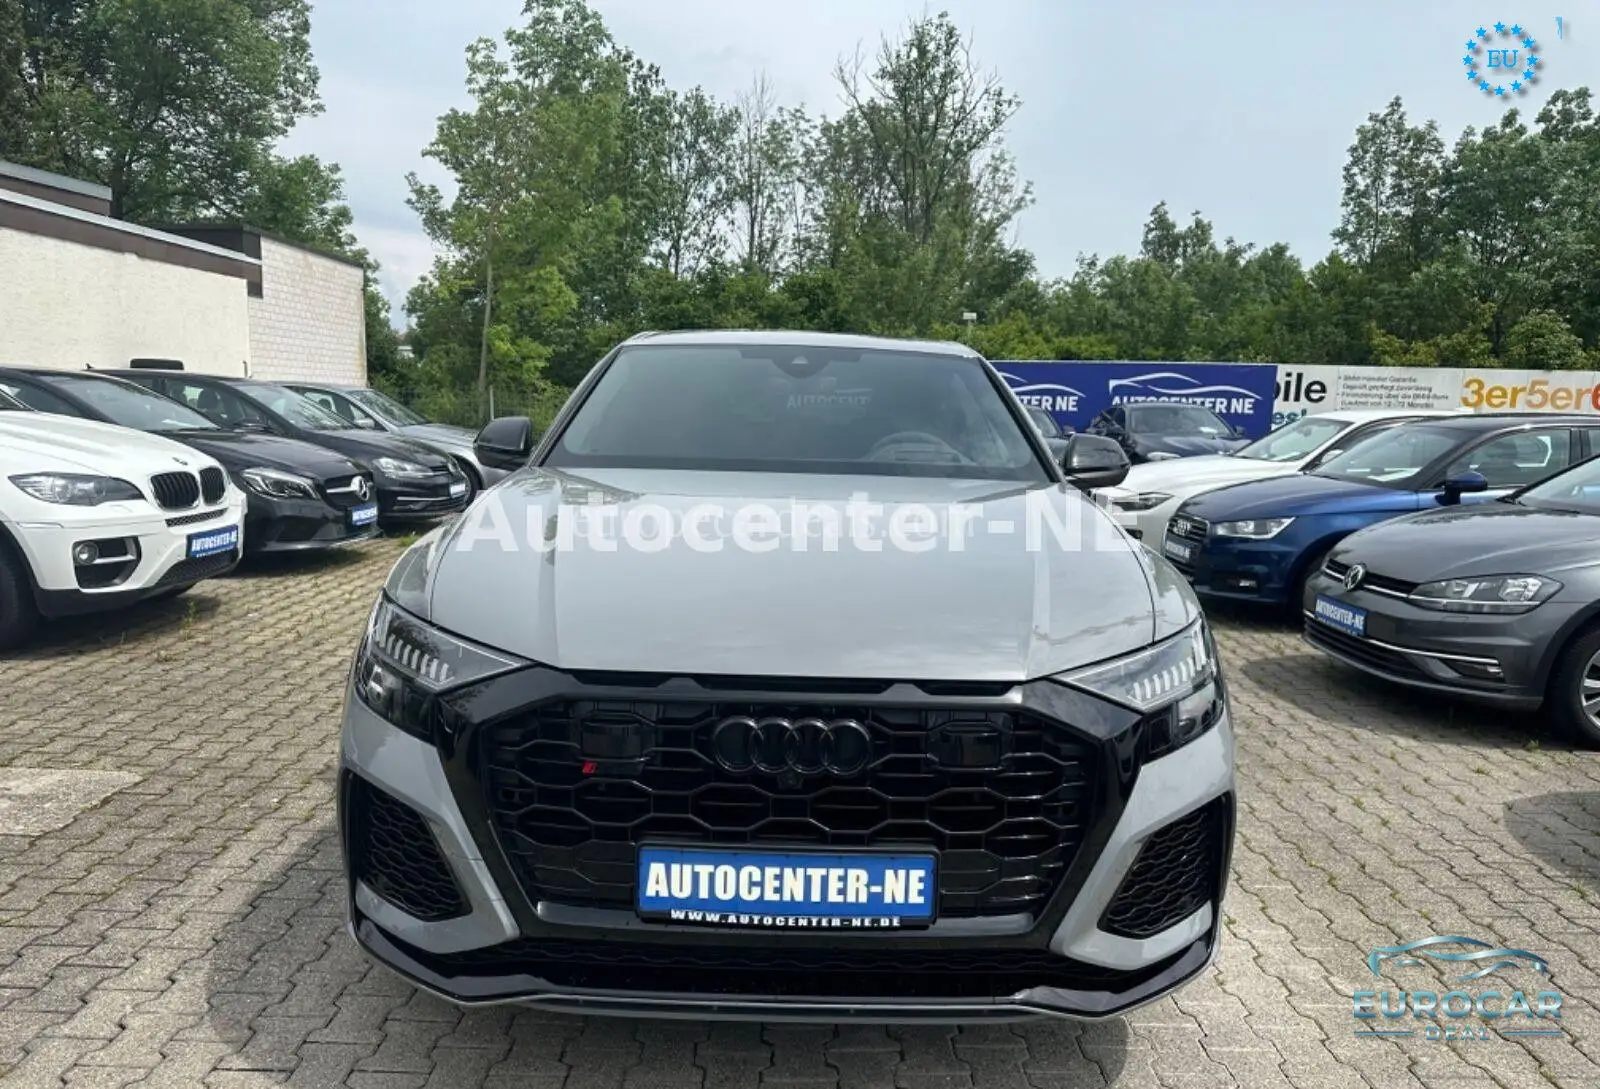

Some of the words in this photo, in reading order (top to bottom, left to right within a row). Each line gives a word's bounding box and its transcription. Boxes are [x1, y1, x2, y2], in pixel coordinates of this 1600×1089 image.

[1055, 395, 1079, 412] NE
[1230, 398, 1255, 414] NE
[645, 862, 926, 904] AUTOCENTER-NE
[670, 908, 901, 927] WWW.AUTOCENTER-NE.DE
